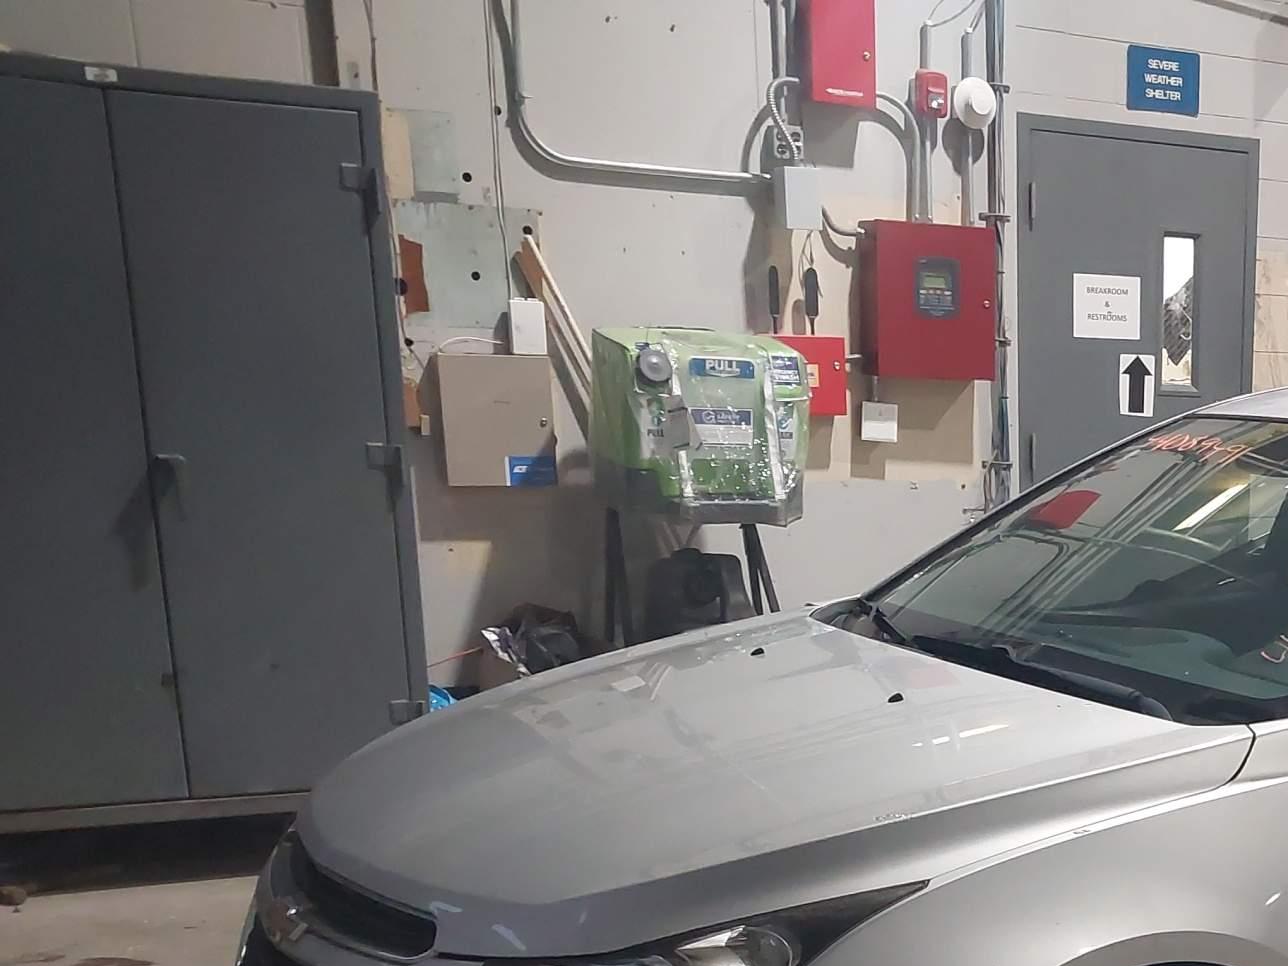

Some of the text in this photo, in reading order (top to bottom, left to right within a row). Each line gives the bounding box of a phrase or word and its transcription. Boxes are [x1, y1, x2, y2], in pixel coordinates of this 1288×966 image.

[1147, 58, 1180, 72] SEVERE
[1144, 73, 1183, 87] WEATHER
[1145, 88, 1181, 101] SHELTER
[1086, 286, 1129, 296] BREAKROOM
[1104, 300, 1110, 308] &
[1087, 312, 1128, 322] RESTROOMS
[705, 358, 741, 372] PULL
